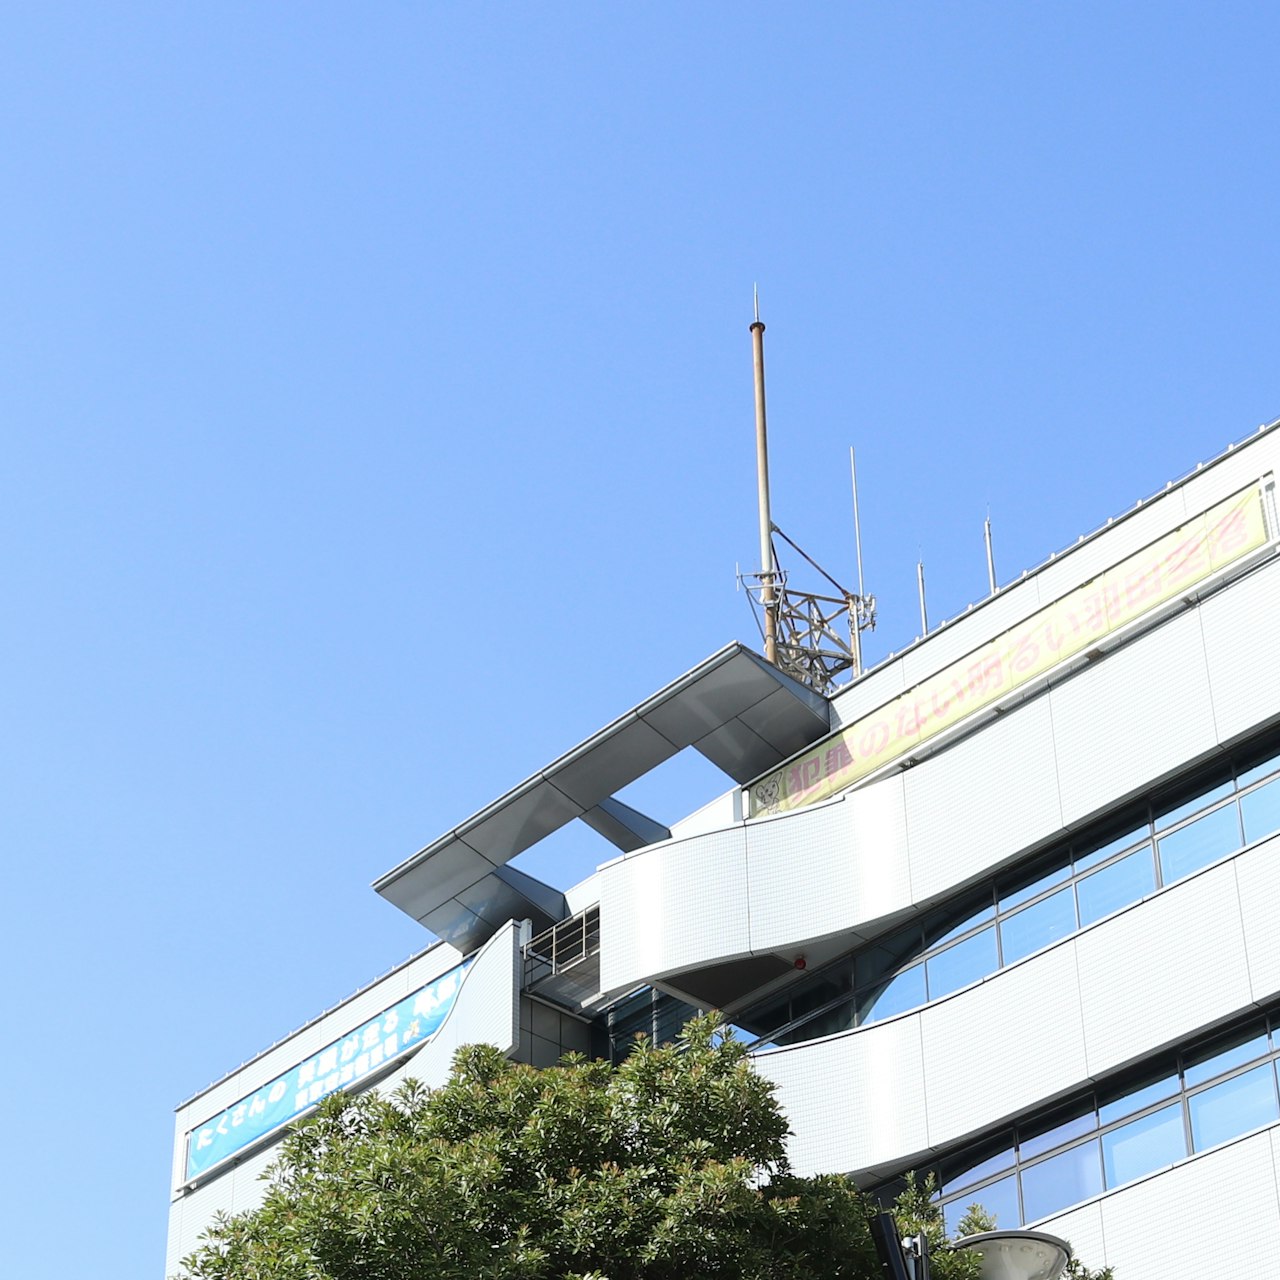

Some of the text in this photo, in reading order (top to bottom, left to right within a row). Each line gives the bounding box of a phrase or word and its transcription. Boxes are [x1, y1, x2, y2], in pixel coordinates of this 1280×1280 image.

[786, 507, 1250, 802] 犯罪のない明るい羽田空港
